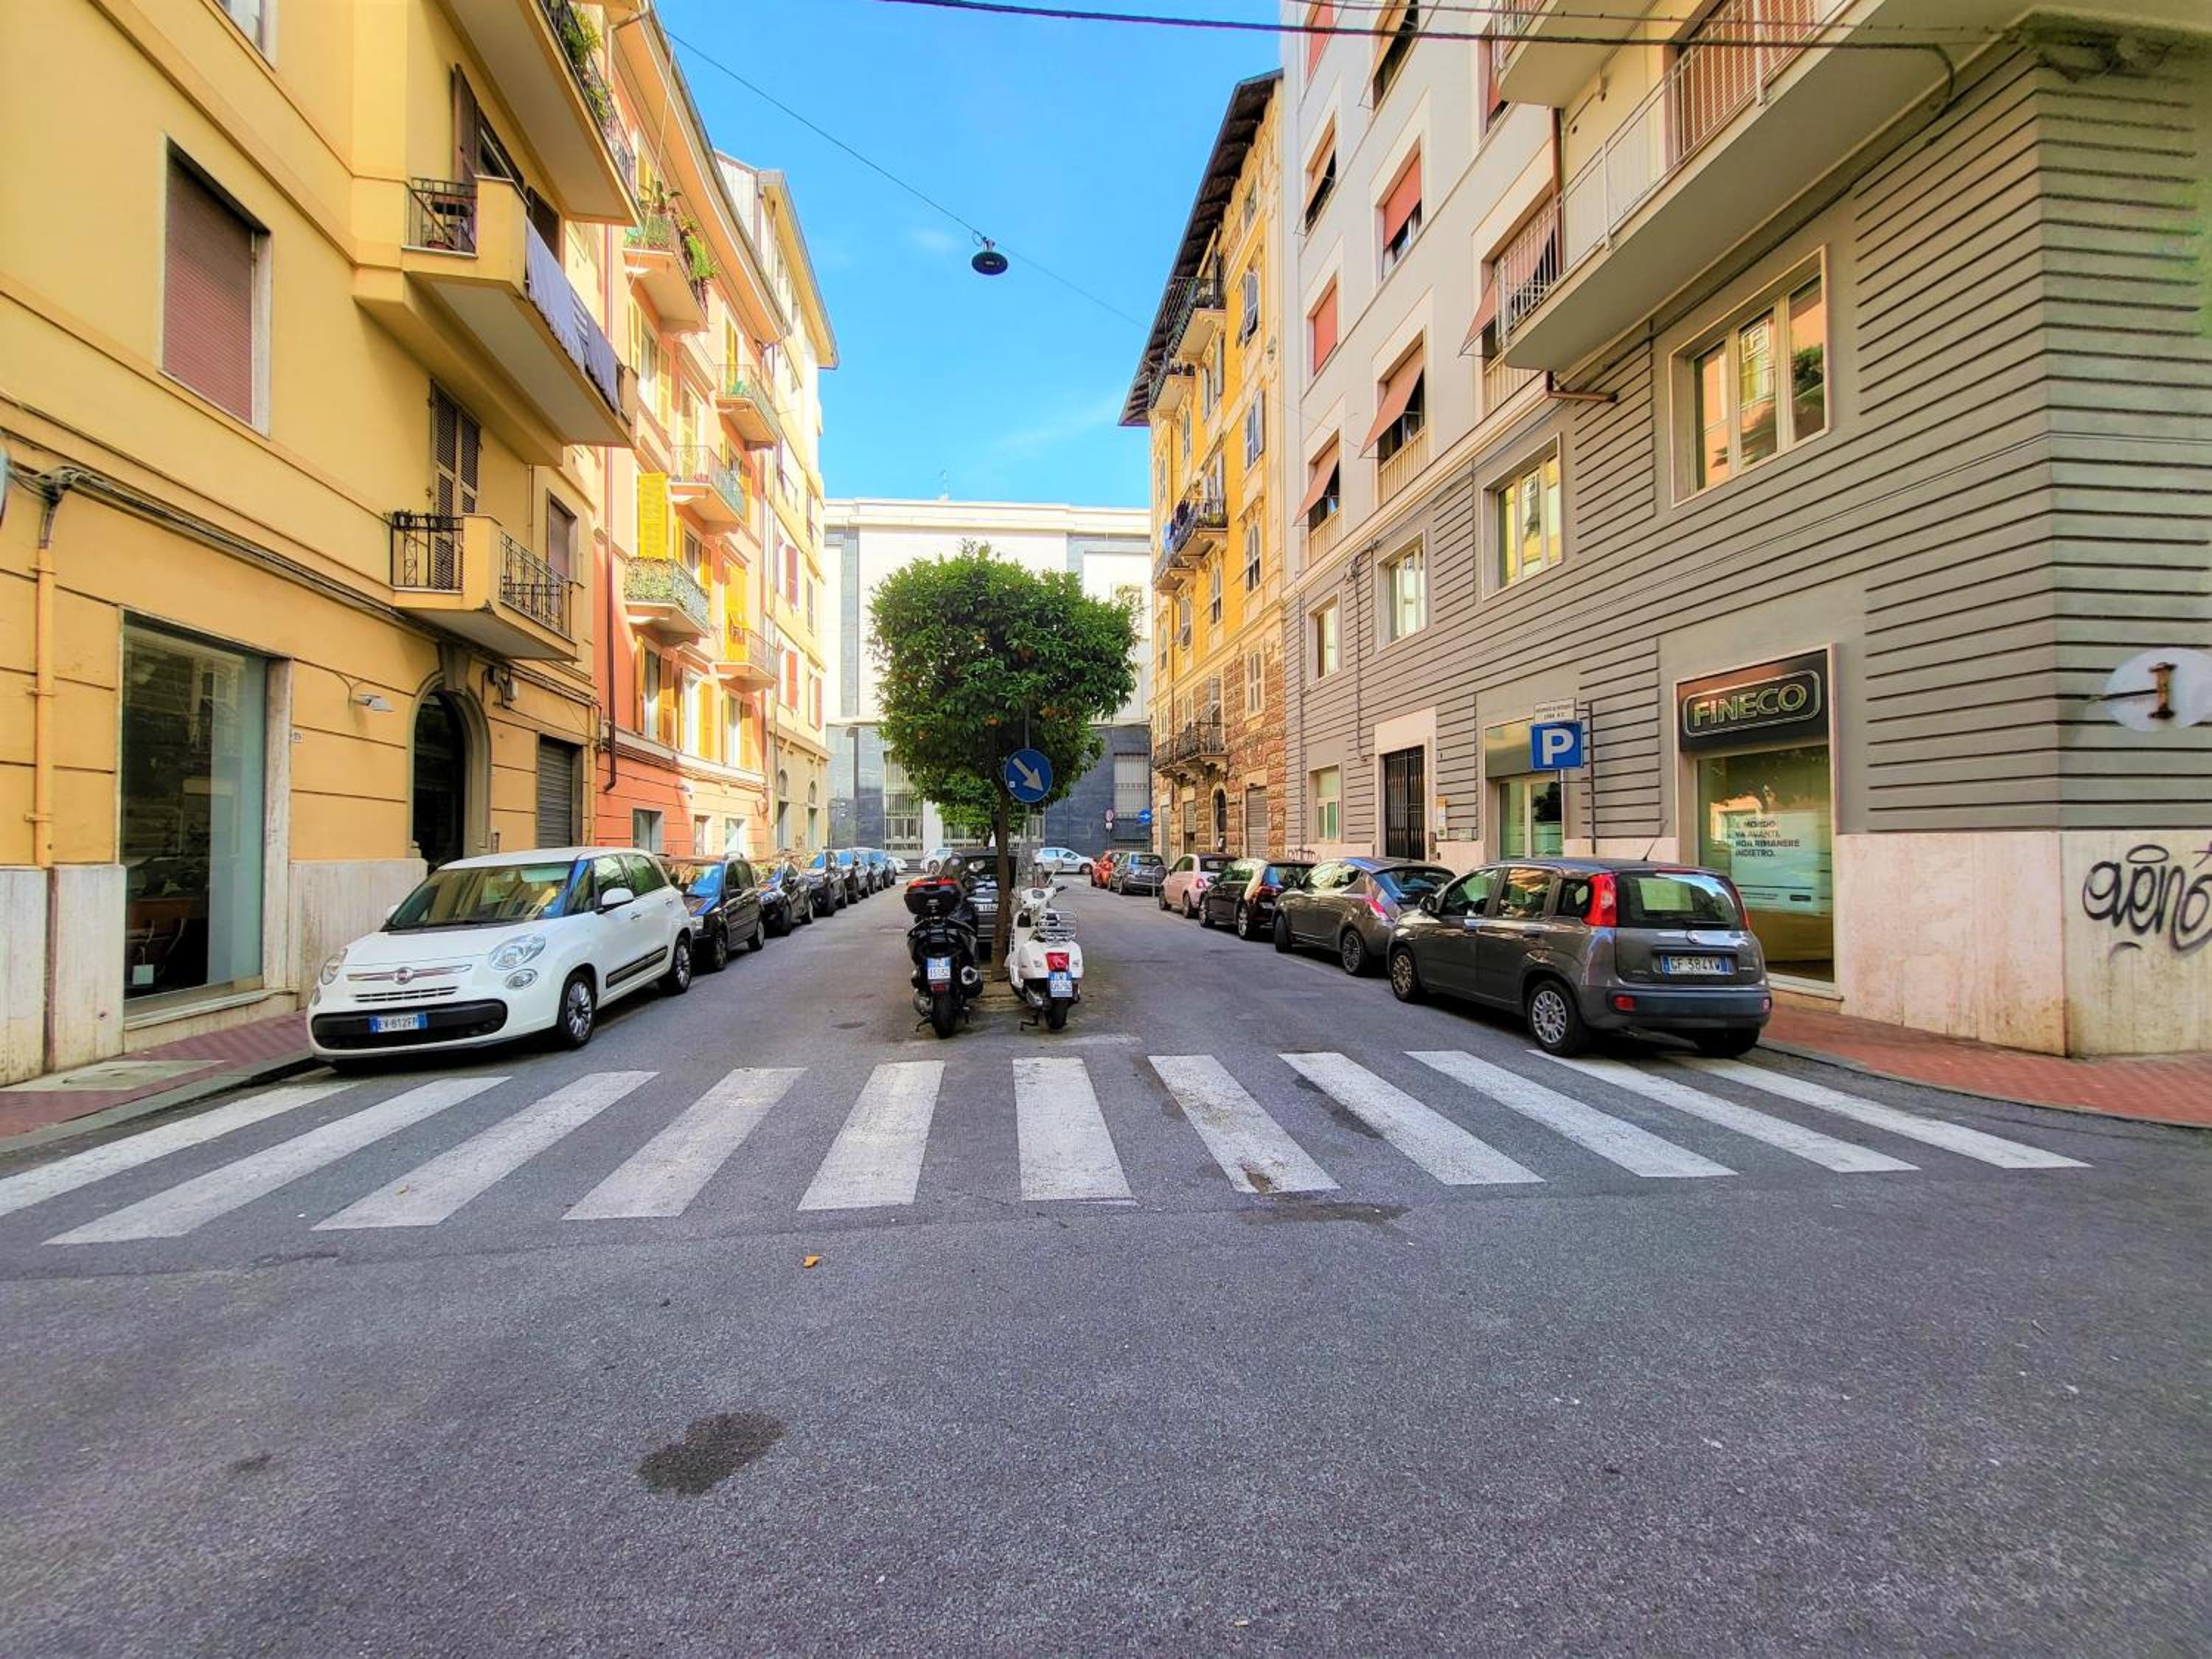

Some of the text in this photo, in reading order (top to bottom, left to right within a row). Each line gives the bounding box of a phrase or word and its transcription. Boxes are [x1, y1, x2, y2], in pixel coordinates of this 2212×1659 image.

[1693, 683, 1807, 727] FINECO
[1542, 728, 1574, 765] P
[1755, 839, 1801, 847] RIMANERE
